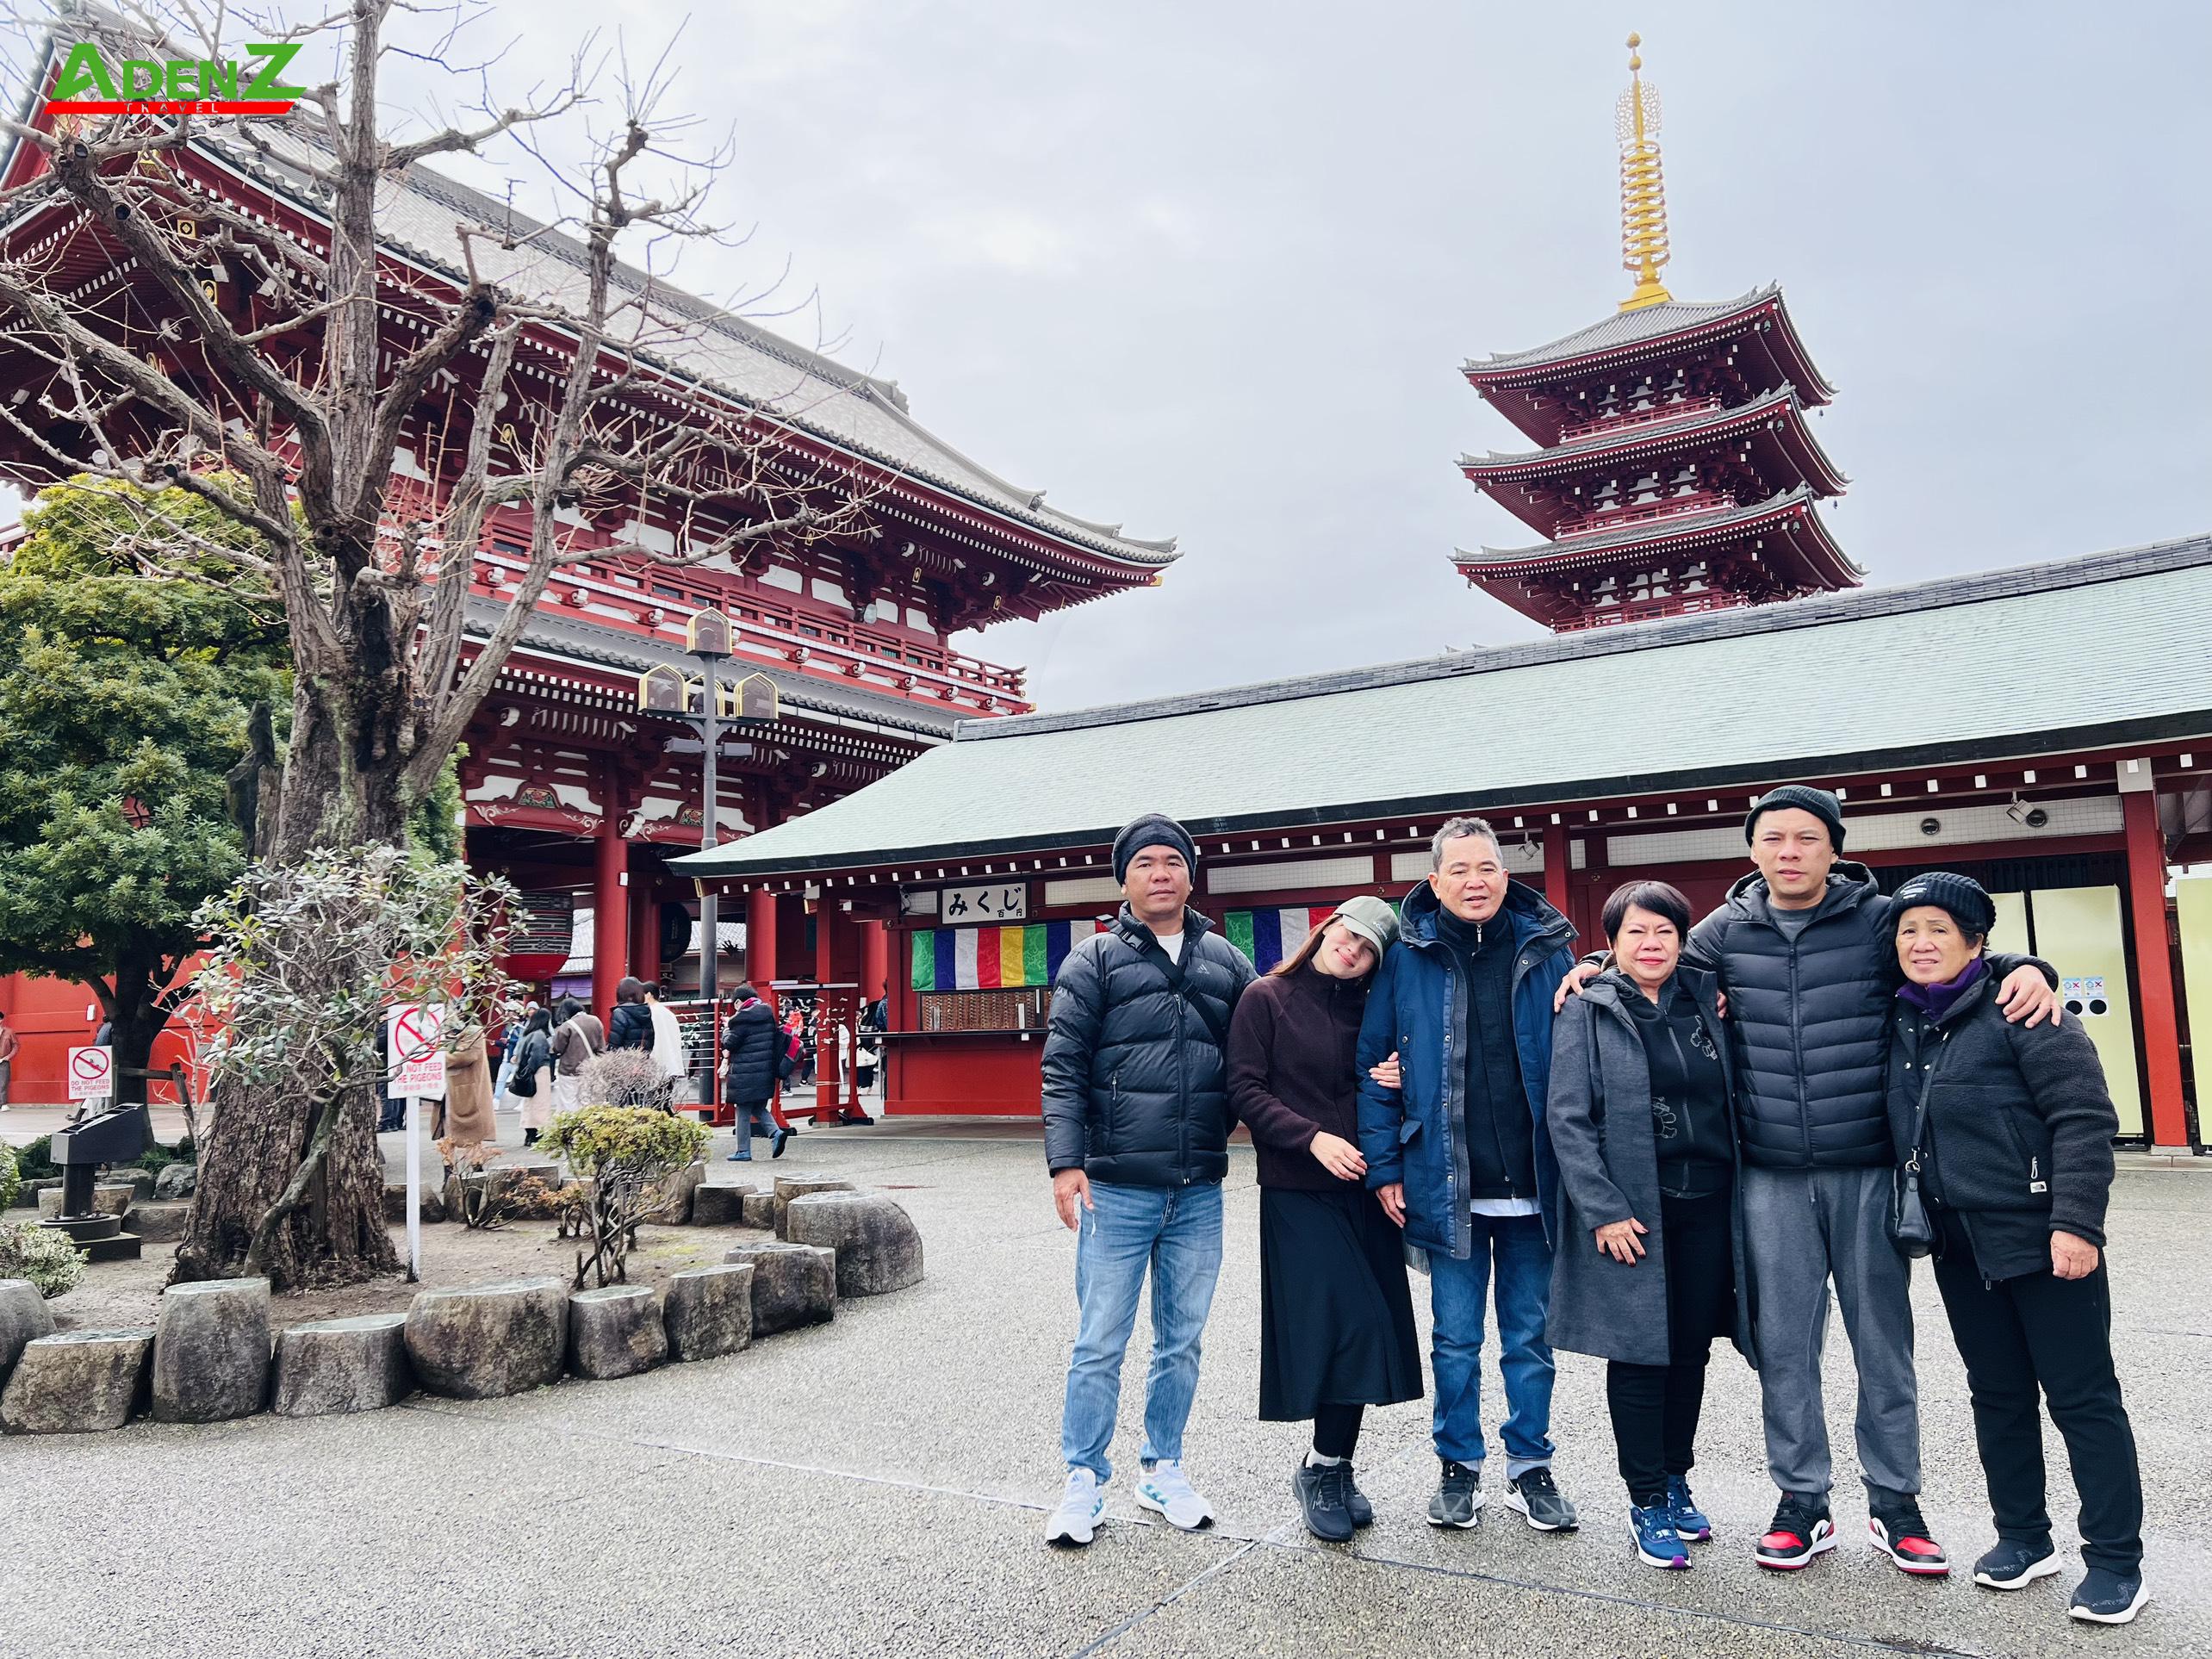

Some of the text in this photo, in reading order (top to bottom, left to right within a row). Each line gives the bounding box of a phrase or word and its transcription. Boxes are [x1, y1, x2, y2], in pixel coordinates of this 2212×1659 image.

[948, 886, 1022, 916] みくじ
[407, 1063, 422, 1072] NOT
[425, 1062, 442, 1072] FEED
[410, 1072, 442, 1083] PIGEONS
